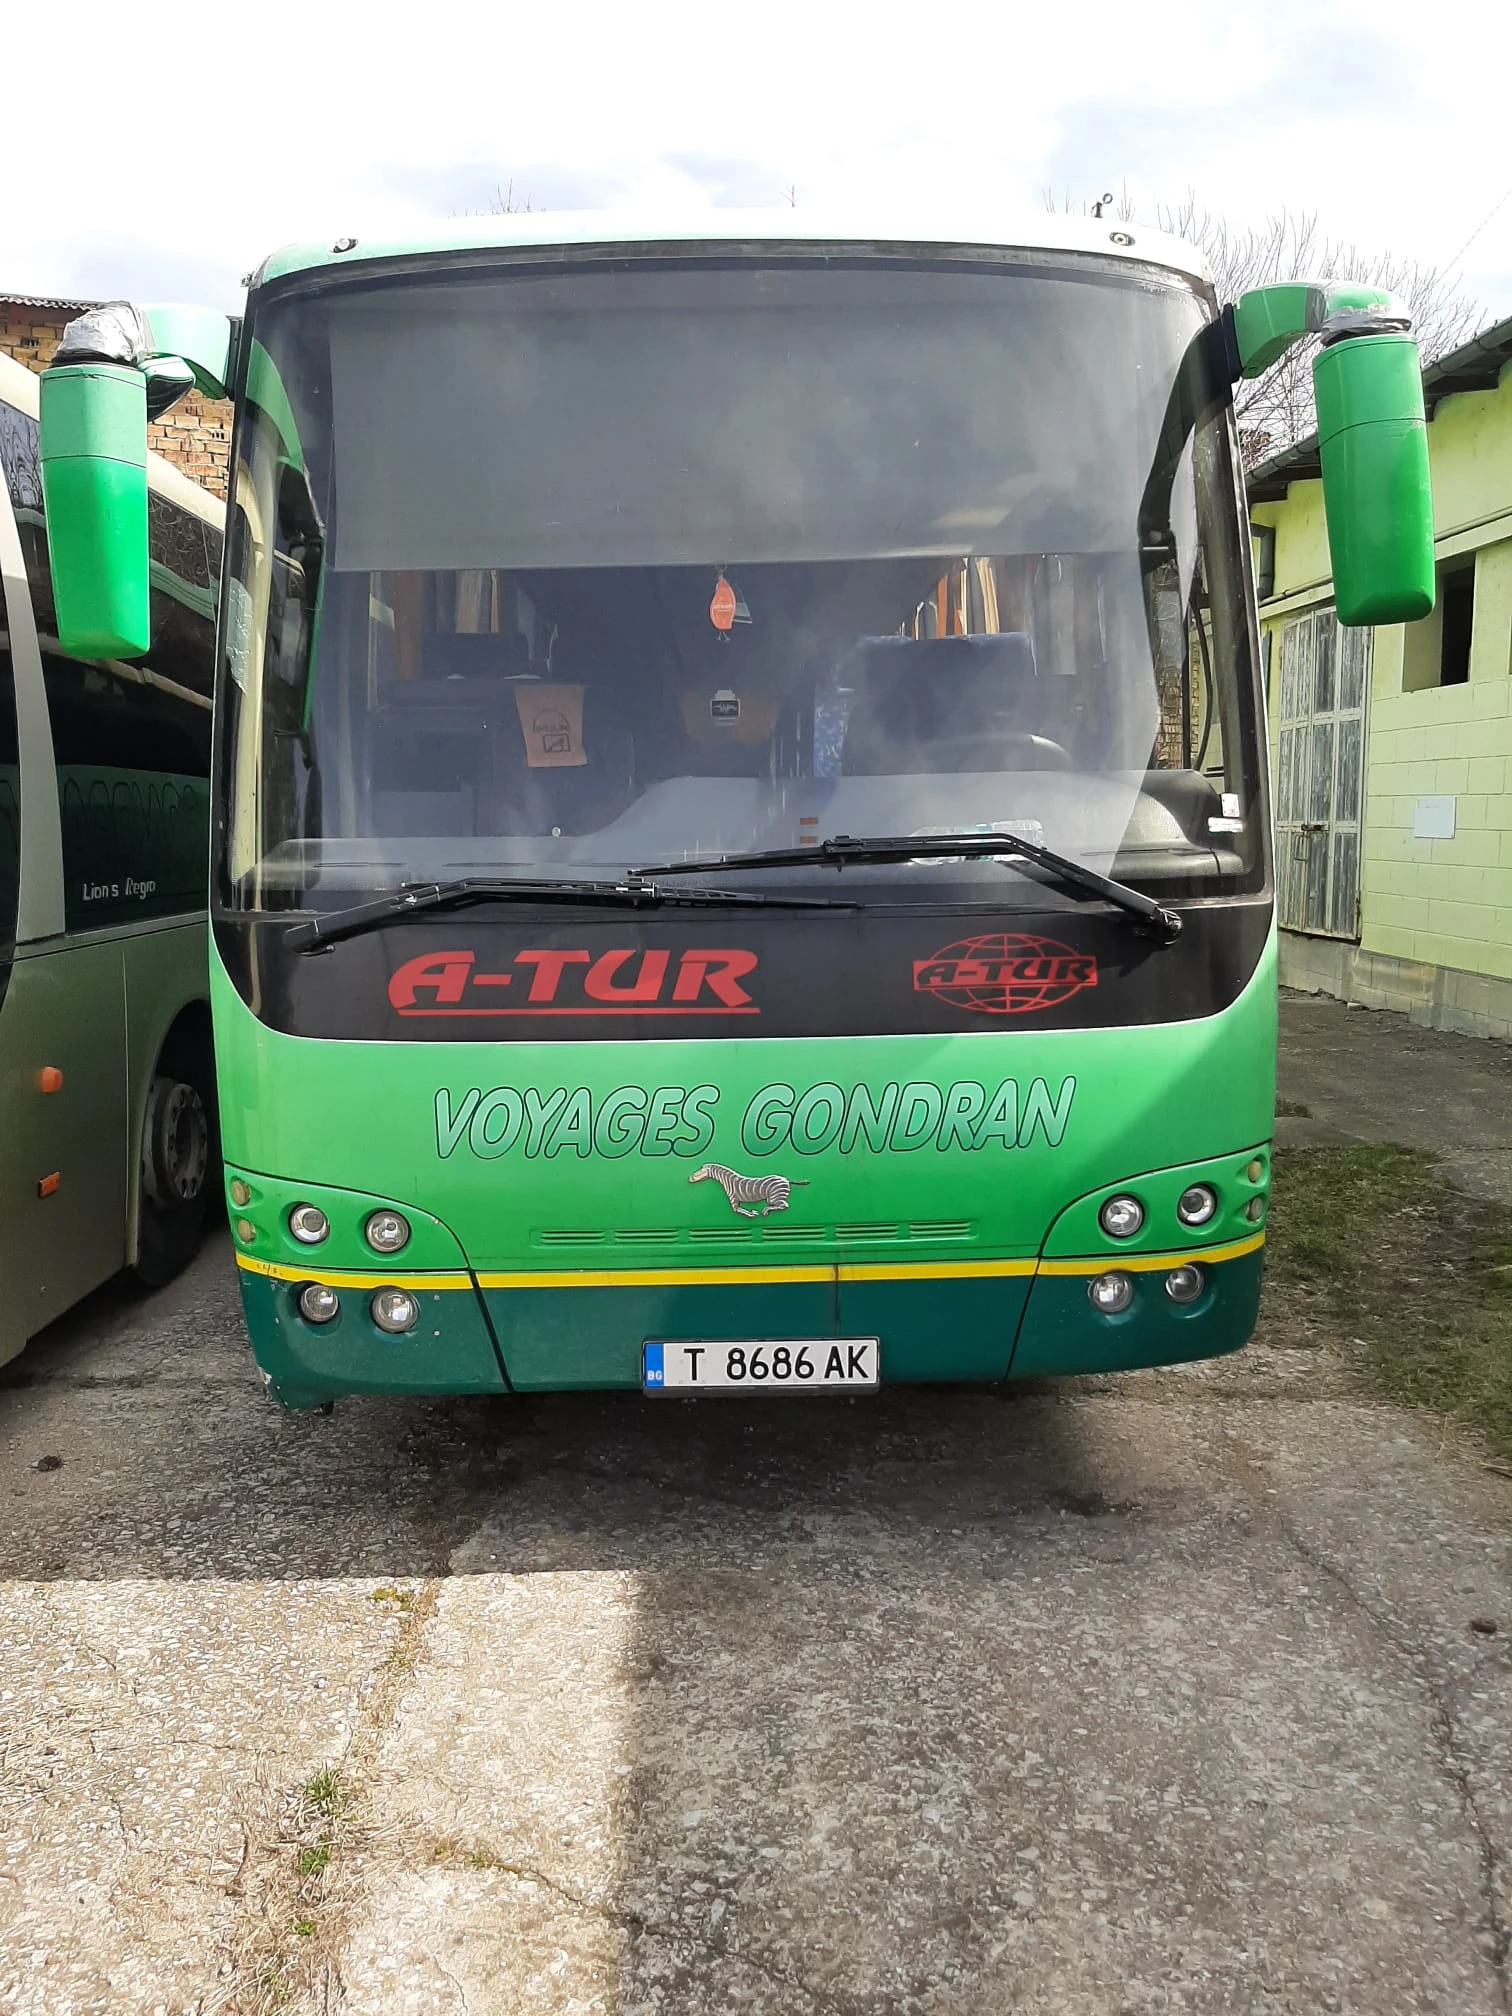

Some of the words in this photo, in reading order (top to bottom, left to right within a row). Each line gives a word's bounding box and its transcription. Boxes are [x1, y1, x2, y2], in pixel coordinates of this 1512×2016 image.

[387, 949, 759, 1010] A-TUR
[916, 959, 1095, 986] A-TUR
[434, 1084, 721, 1160] VOYAGES
[740, 1075, 1077, 1157] GONDRAN
[647, 1370, 663, 1381] BG
[683, 1347, 706, 1381] T
[726, 1346, 815, 1380] 8686
[823, 1345, 870, 1379] AK
